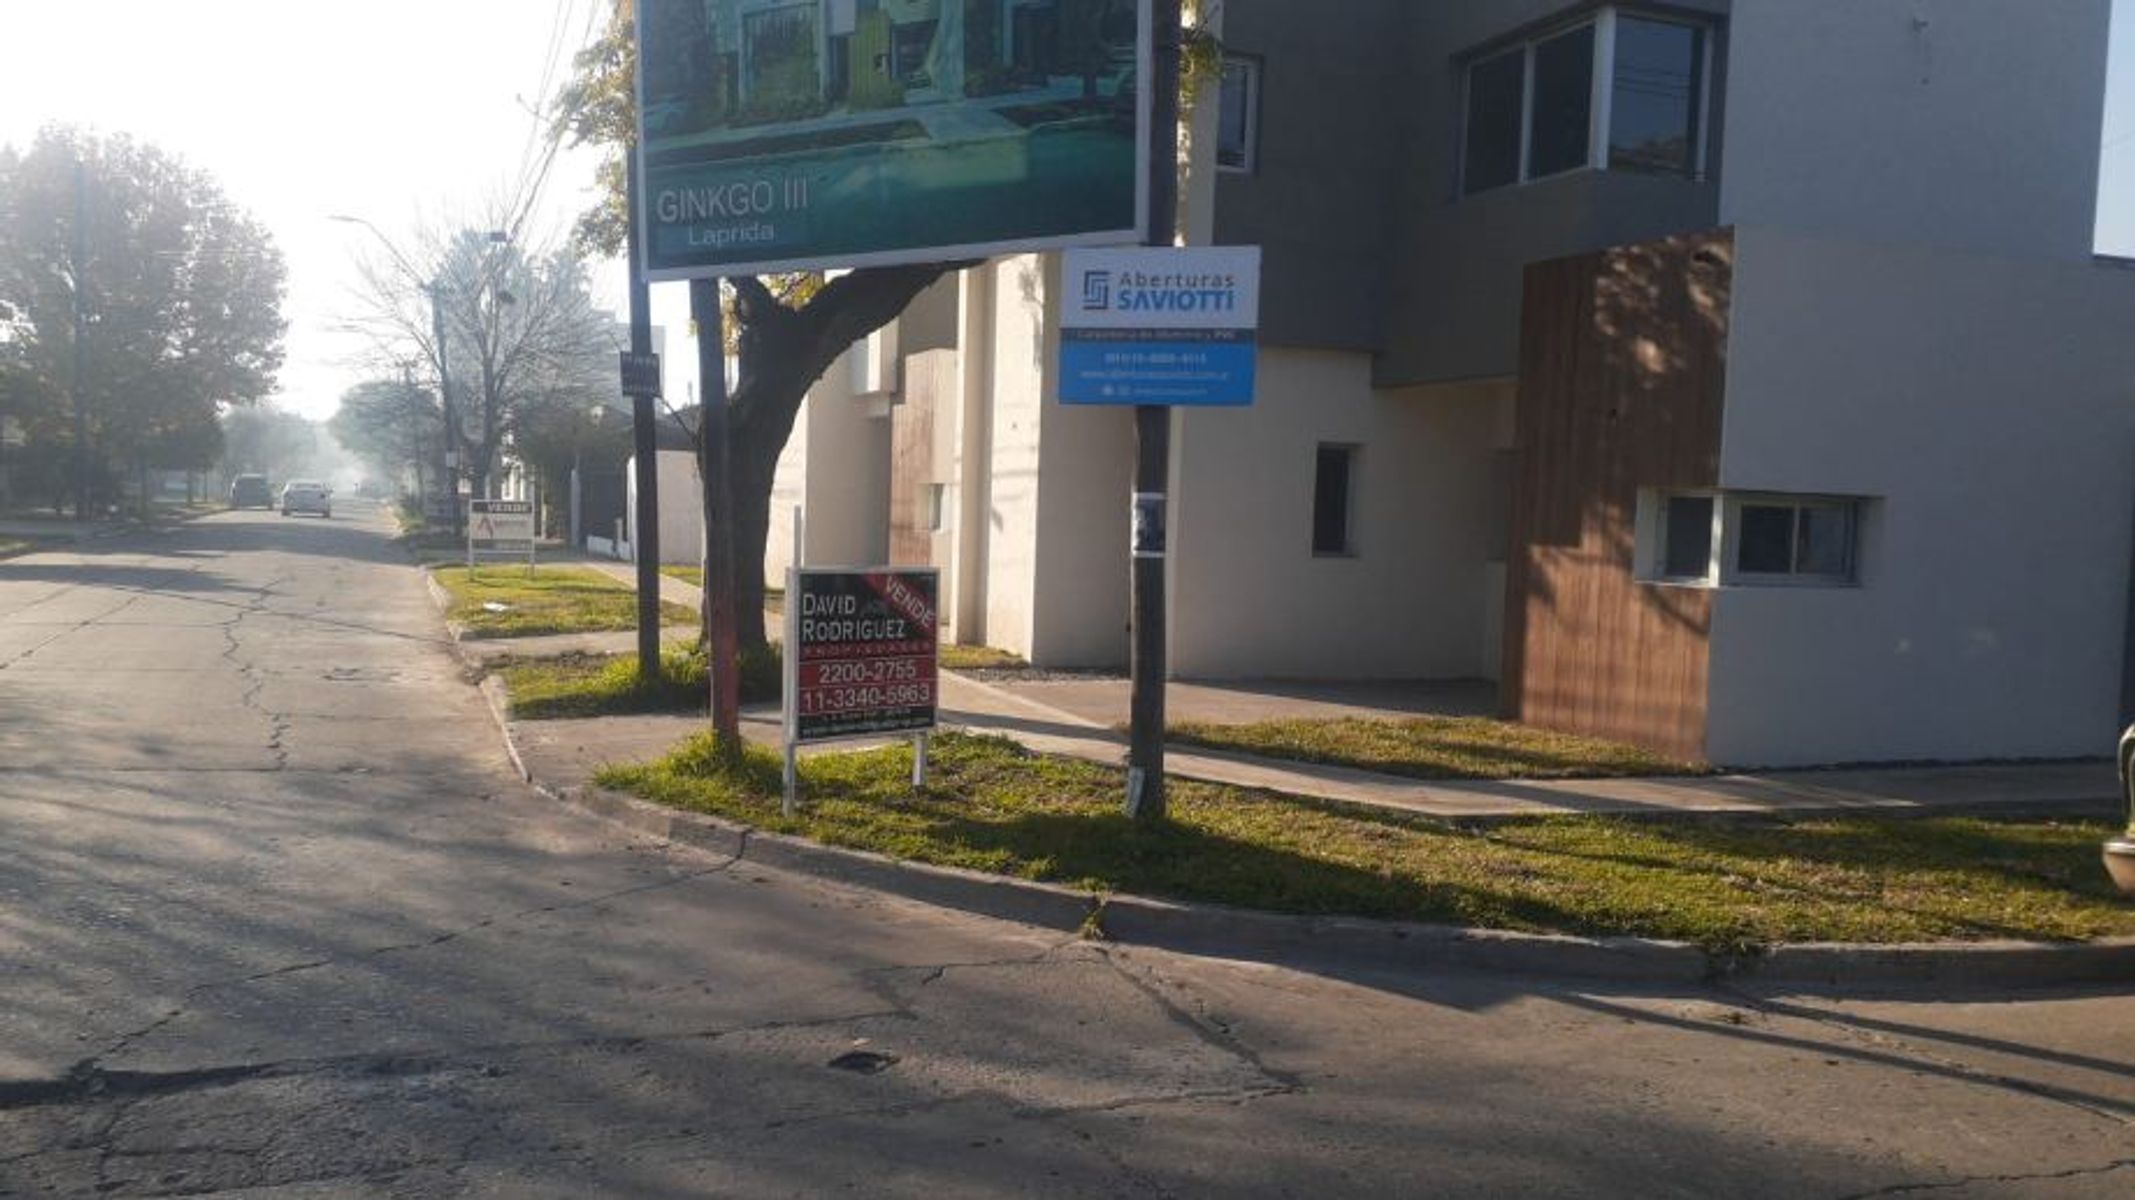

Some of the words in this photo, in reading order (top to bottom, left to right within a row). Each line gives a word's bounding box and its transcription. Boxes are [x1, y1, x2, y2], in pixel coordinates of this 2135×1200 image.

[657, 180, 773, 223] GINKGO
[783, 175, 808, 210] III
[688, 222, 775, 249] Laprida
[1119, 270, 1235, 288] Aberturas
[802, 593, 856, 615] DAVID
[885, 575, 936, 628] VENDE
[802, 619, 905, 641] RODRIGUEZ
[819, 660, 916, 683] 2200-2755
